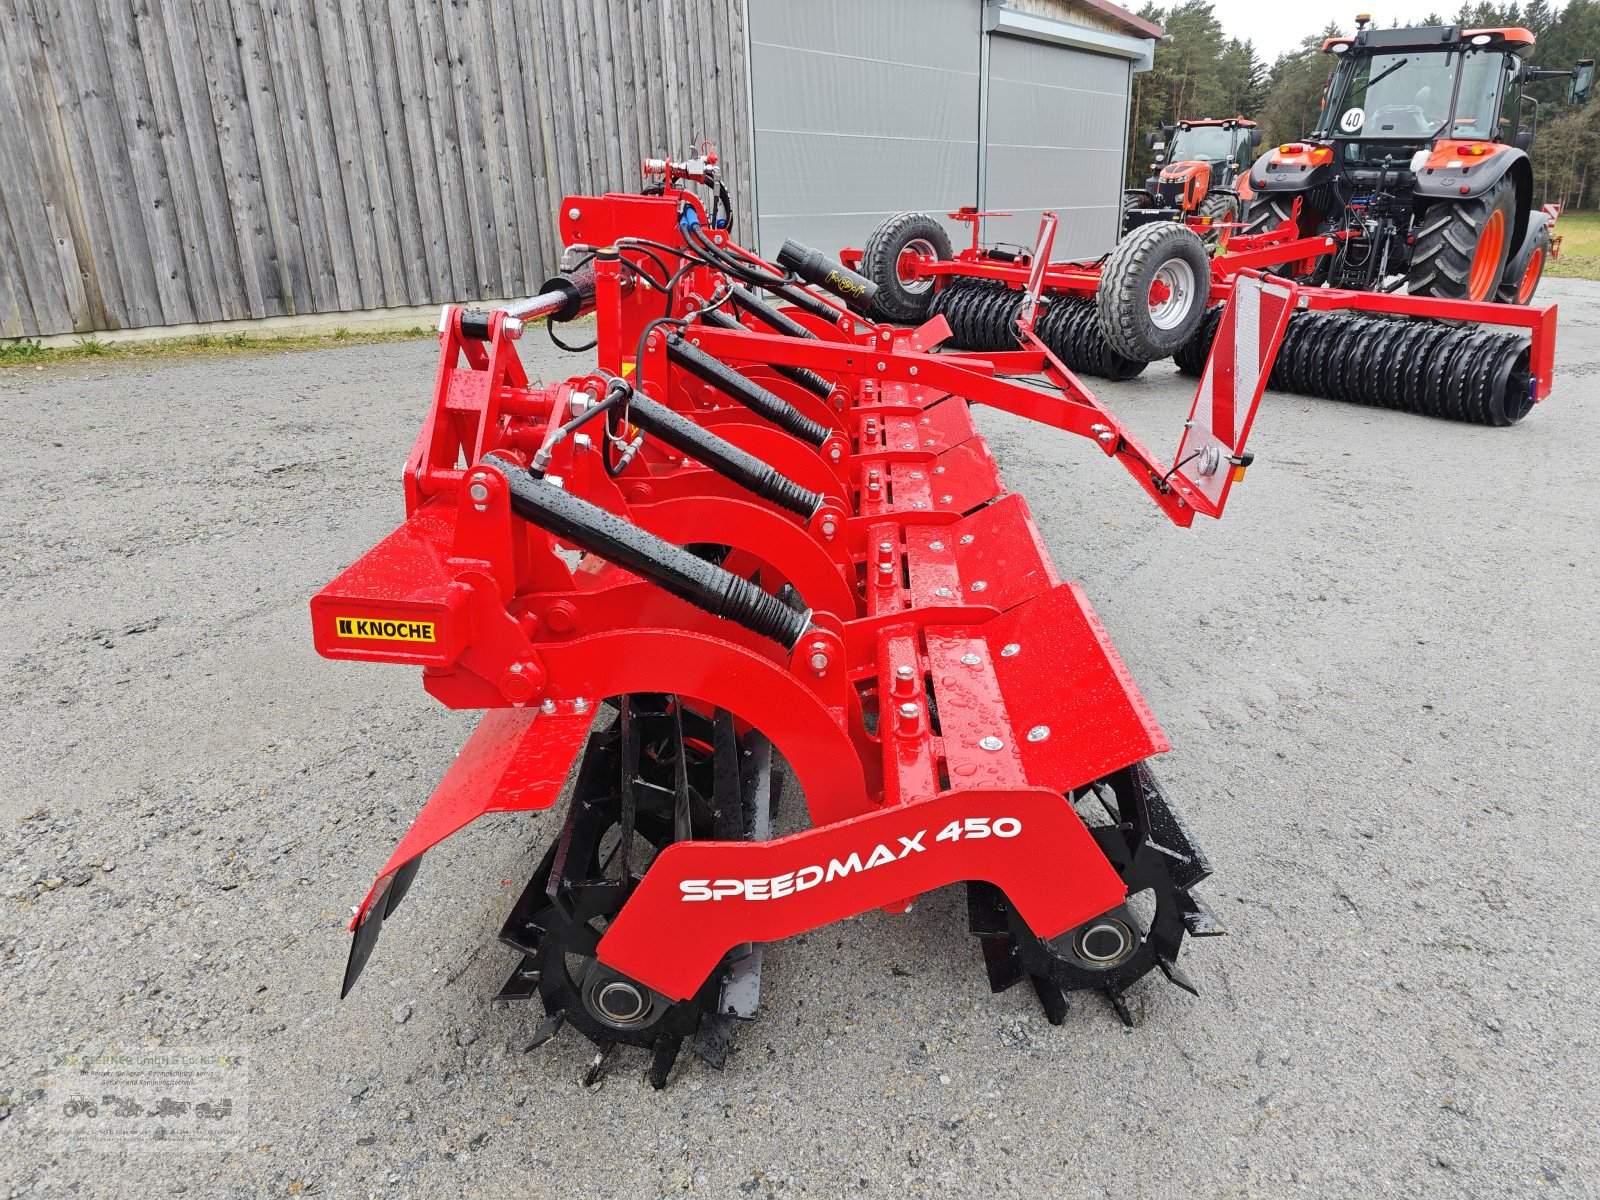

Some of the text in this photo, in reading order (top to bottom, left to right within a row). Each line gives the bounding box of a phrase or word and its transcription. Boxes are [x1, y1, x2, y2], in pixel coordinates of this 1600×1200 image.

[1345, 113, 1361, 127] 40
[356, 620, 433, 643] KNOCHE
[679, 817, 1022, 902] SPEEDMAX 450
